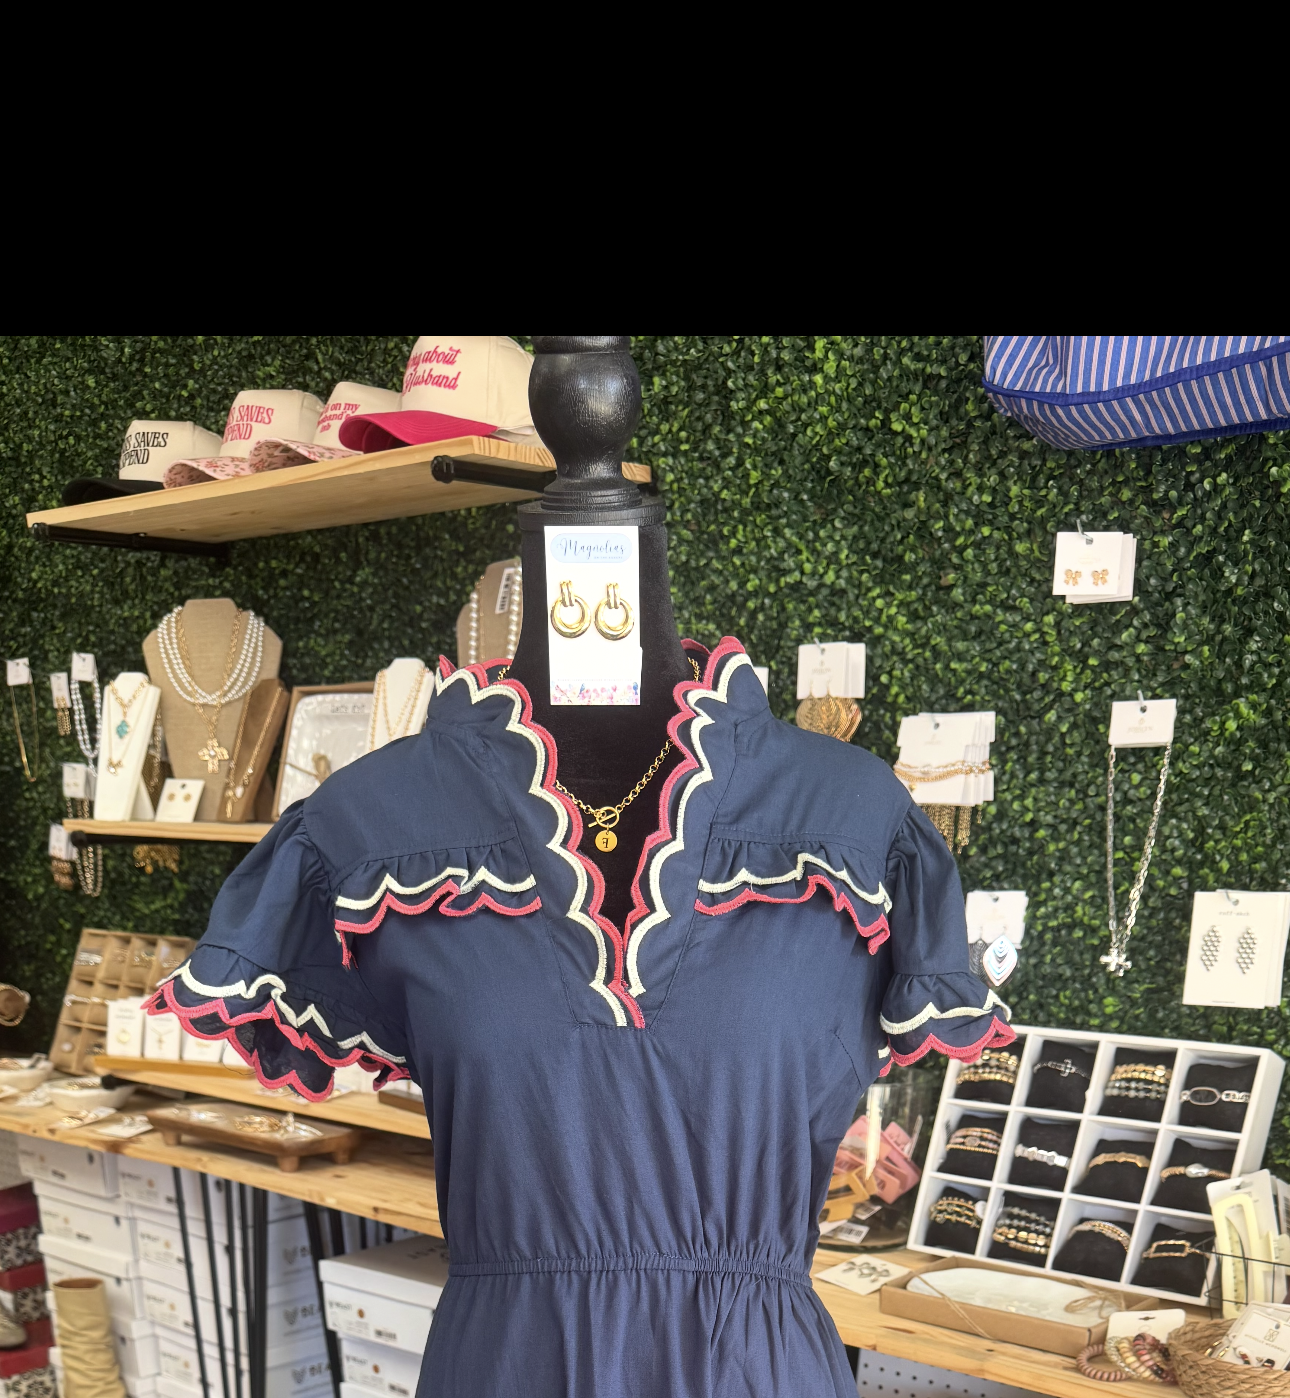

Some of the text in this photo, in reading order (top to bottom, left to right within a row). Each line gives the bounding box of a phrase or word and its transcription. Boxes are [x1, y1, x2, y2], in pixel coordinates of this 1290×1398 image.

[421, 345, 461, 365] about
[235, 405, 274, 425] SAVES
[330, 403, 342, 411] on
[343, 403, 361, 414] my
[133, 432, 169, 448] SAVES
